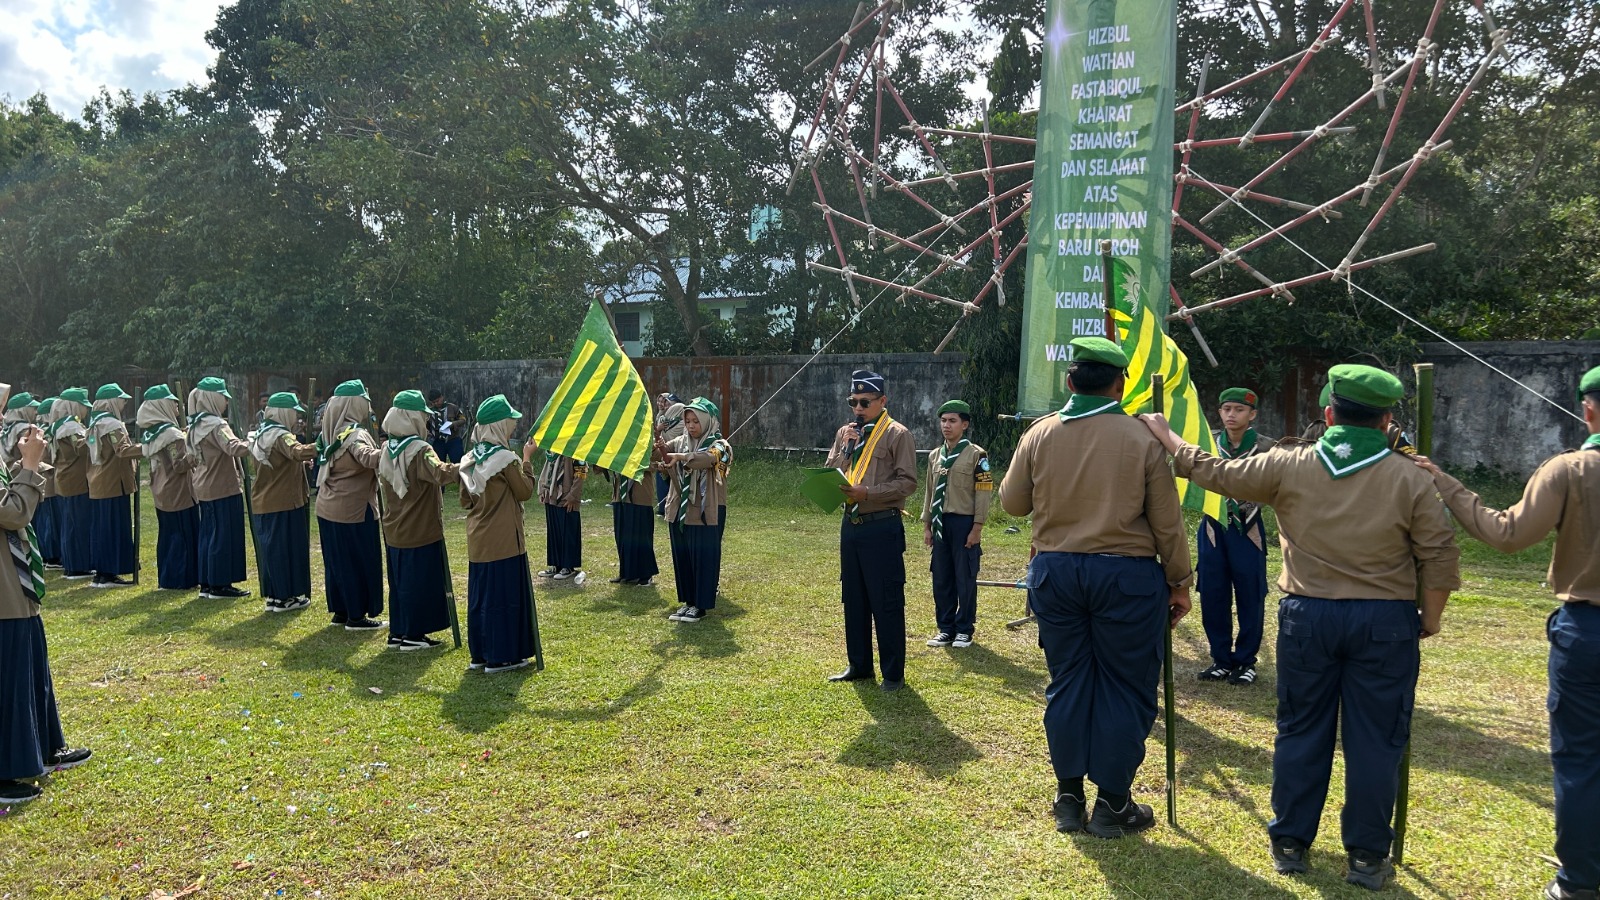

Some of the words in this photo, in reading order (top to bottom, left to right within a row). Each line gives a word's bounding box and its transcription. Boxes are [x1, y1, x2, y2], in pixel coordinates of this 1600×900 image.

[1088, 25, 1131, 46] HIZBUL
[1082, 51, 1135, 73] WATHAN
[1071, 77, 1142, 100] FASTABIQUL
[1078, 104, 1133, 125] KHAIRAT
[1069, 130, 1139, 150] SEMANGAT
[1061, 159, 1086, 178] DAN
[1089, 157, 1147, 176] SELAMAT
[1083, 185, 1118, 203] ATAS
[1054, 210, 1148, 230] KEPEMIMPINAN
[1058, 238, 1092, 256] BARU
[1055, 292, 1105, 309] KEMBAL
[1072, 318, 1116, 336] HIZBU
